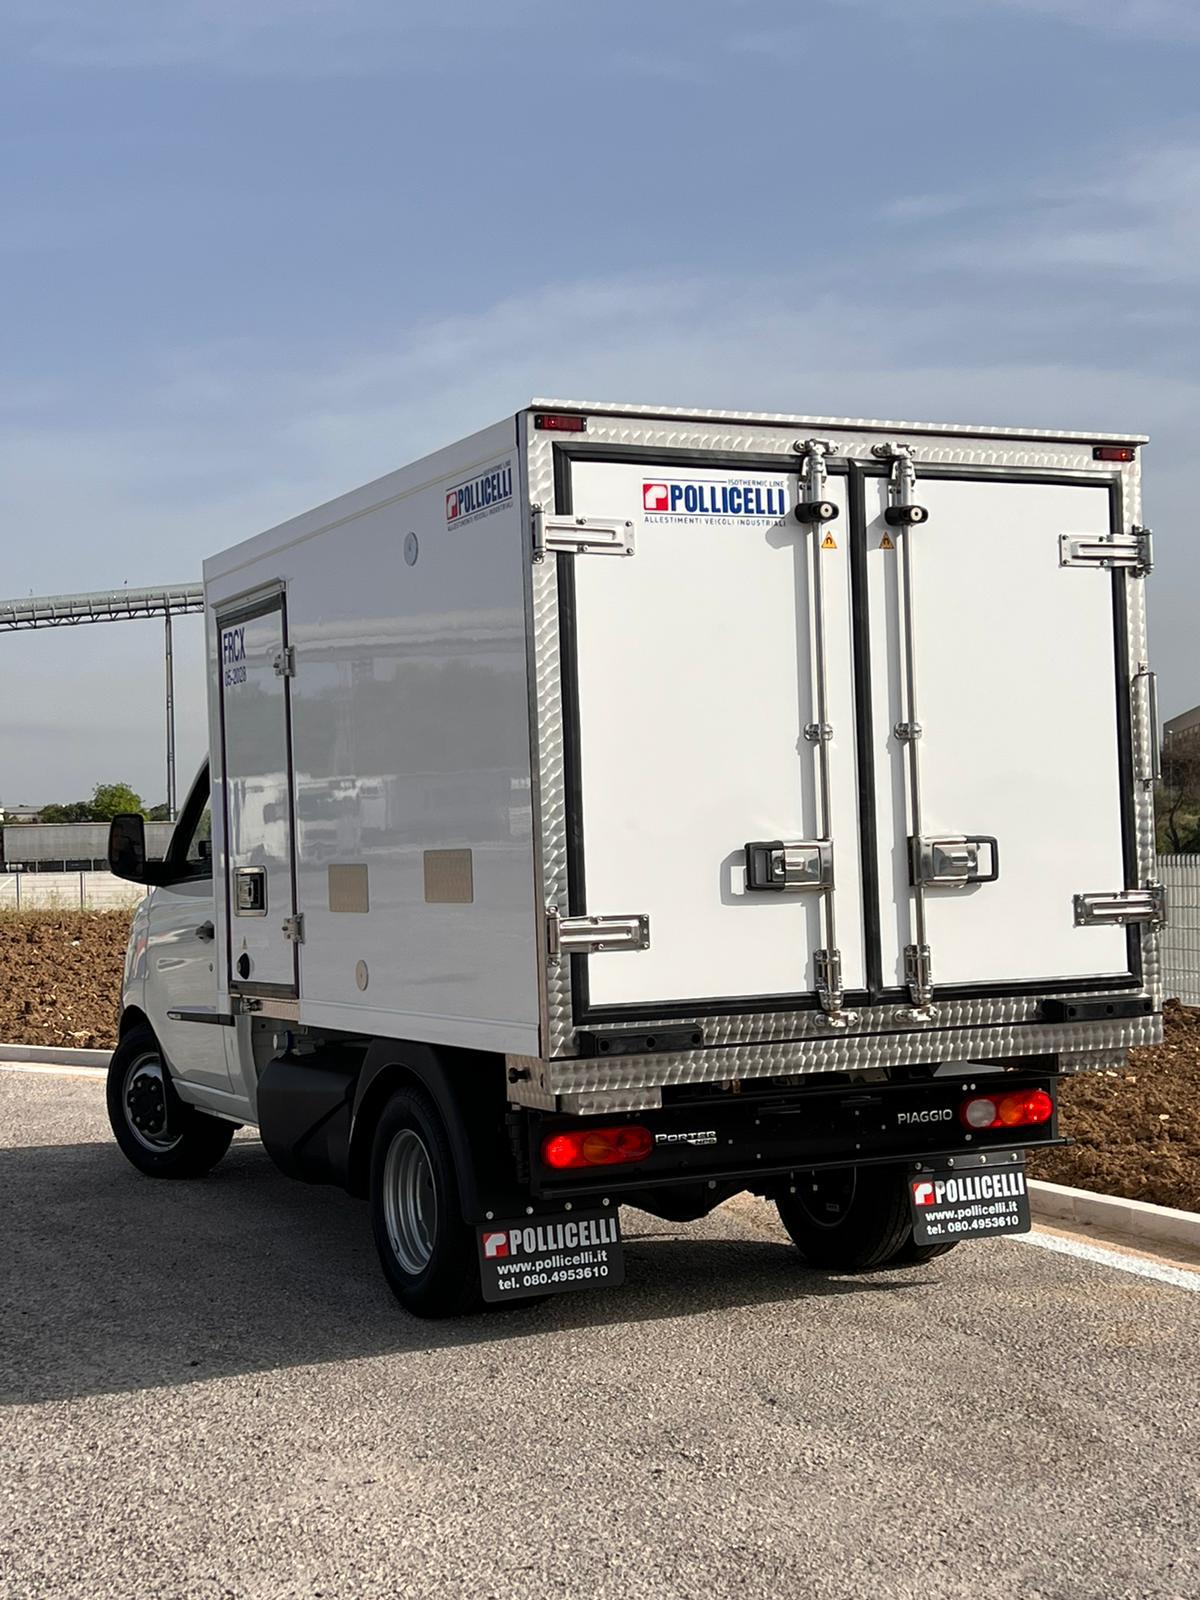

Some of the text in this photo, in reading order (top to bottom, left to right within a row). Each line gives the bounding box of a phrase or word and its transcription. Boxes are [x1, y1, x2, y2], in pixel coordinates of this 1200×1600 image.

[457, 467, 512, 516] POLLICELLI
[727, 478, 785, 488] ISOTHERMIC LINE
[670, 484, 785, 516] POLLICELLI
[644, 516, 786, 528] ALLESTIMENTI VEICOLI INDUSTRIALI
[223, 626, 246, 665] FRCX
[897, 1108, 953, 1125] PIAGGIO
[655, 1130, 716, 1143] PORTER
[934, 1172, 1026, 1204] POLLICELLI
[925, 1201, 1018, 1222] www.pollicelli.it
[509, 1217, 618, 1256] POLLICELLI
[926, 1215, 1019, 1236] tel. 080.4953610
[497, 1250, 608, 1275] www.pollicelli.it
[498, 1265, 609, 1290] tel. 080.4953610
